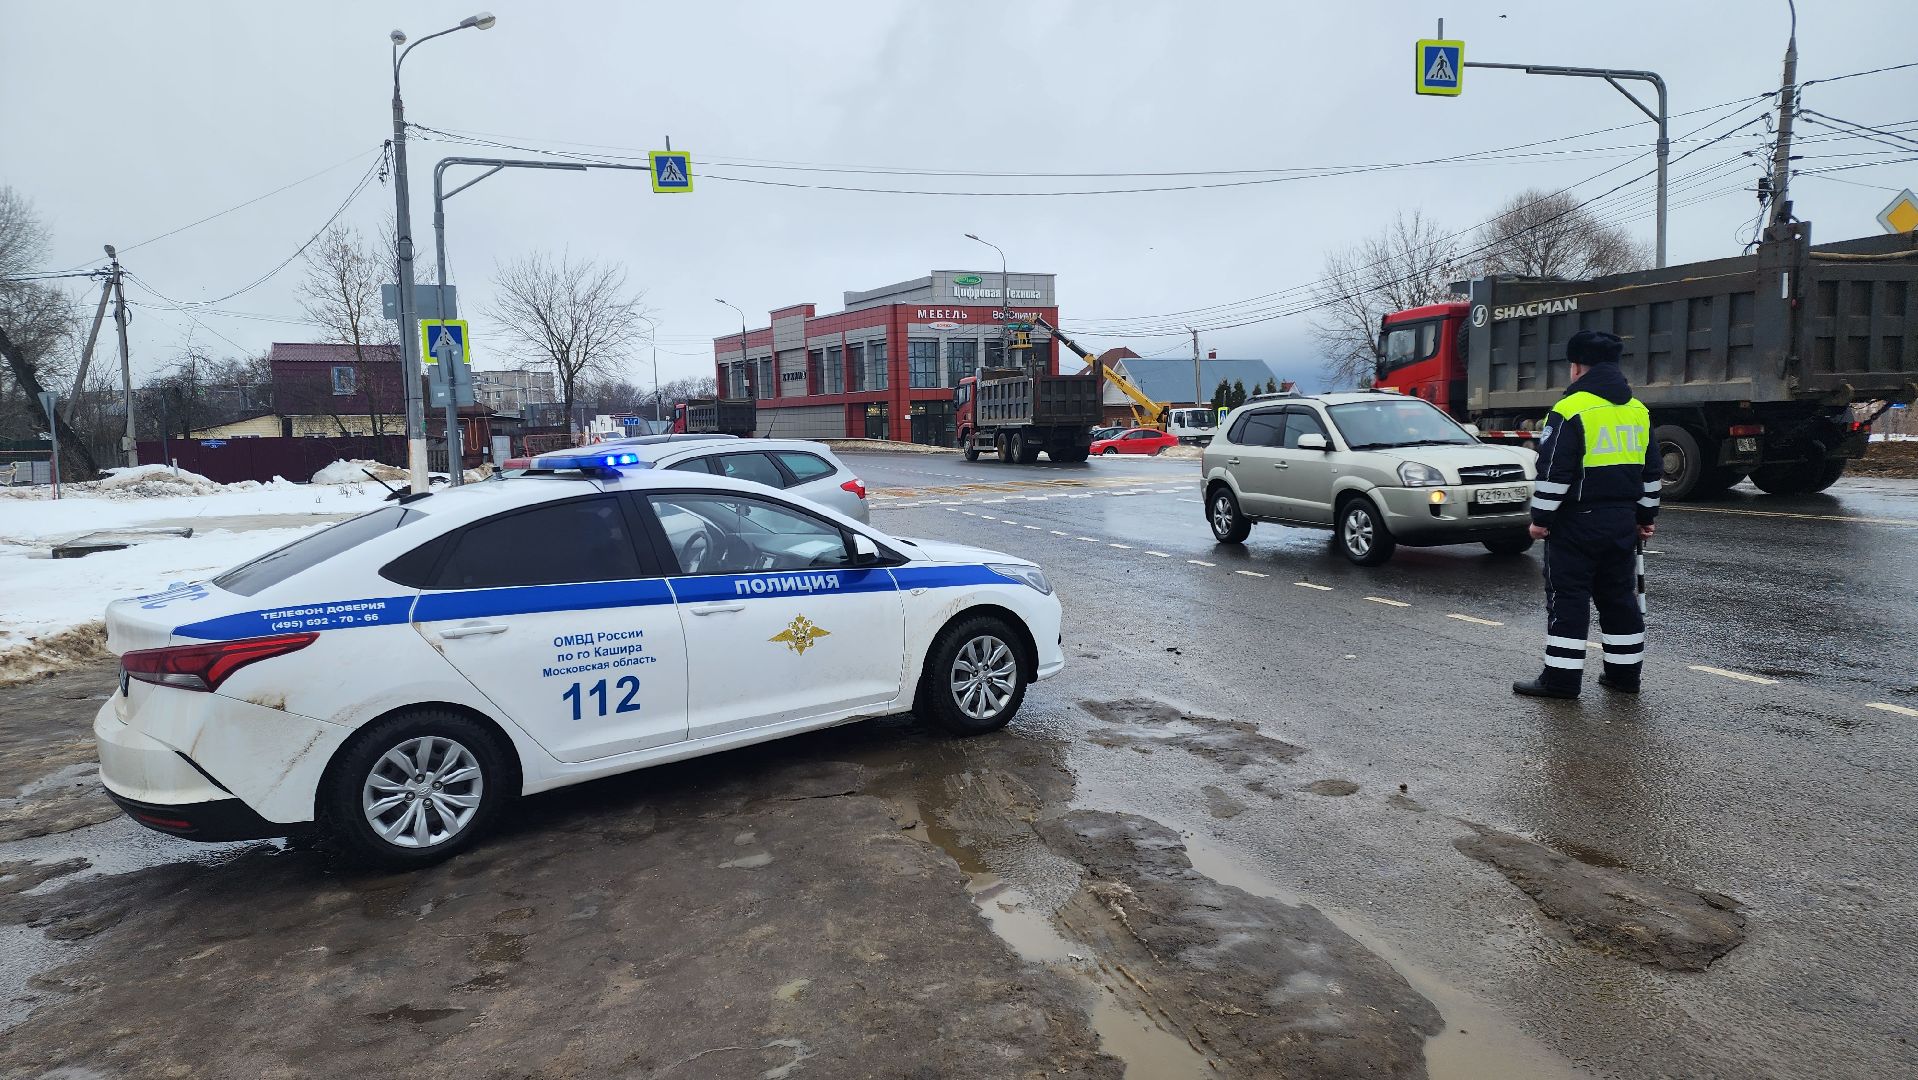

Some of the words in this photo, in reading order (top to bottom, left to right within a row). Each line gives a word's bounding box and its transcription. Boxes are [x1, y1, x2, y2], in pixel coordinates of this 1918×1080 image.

[953, 286, 1001, 300] Цифровая
[917, 309, 968, 320] МЕБЕЛЬ
[1494, 298, 1578, 320] SHACMAN
[1591, 425, 1644, 455] ДПС
[734, 575, 840, 594] ПОЛИЦИЯ
[261, 607, 323, 620] ТЕЛЕФОН
[326, 602, 386, 614] ДОВЕРИЯ
[271, 620, 303, 631] (495)
[306, 617, 329, 626] 692
[339, 615, 354, 623] 70
[364, 613, 379, 622] 66
[553, 633, 595, 647] ОМВД
[597, 629, 644, 642] России
[557, 653, 573, 662] по
[577, 650, 590, 659] го
[594, 644, 643, 658] Кашира
[542, 661, 610, 678] Московская
[613, 656, 657, 668] область
[562, 675, 641, 721] 112
